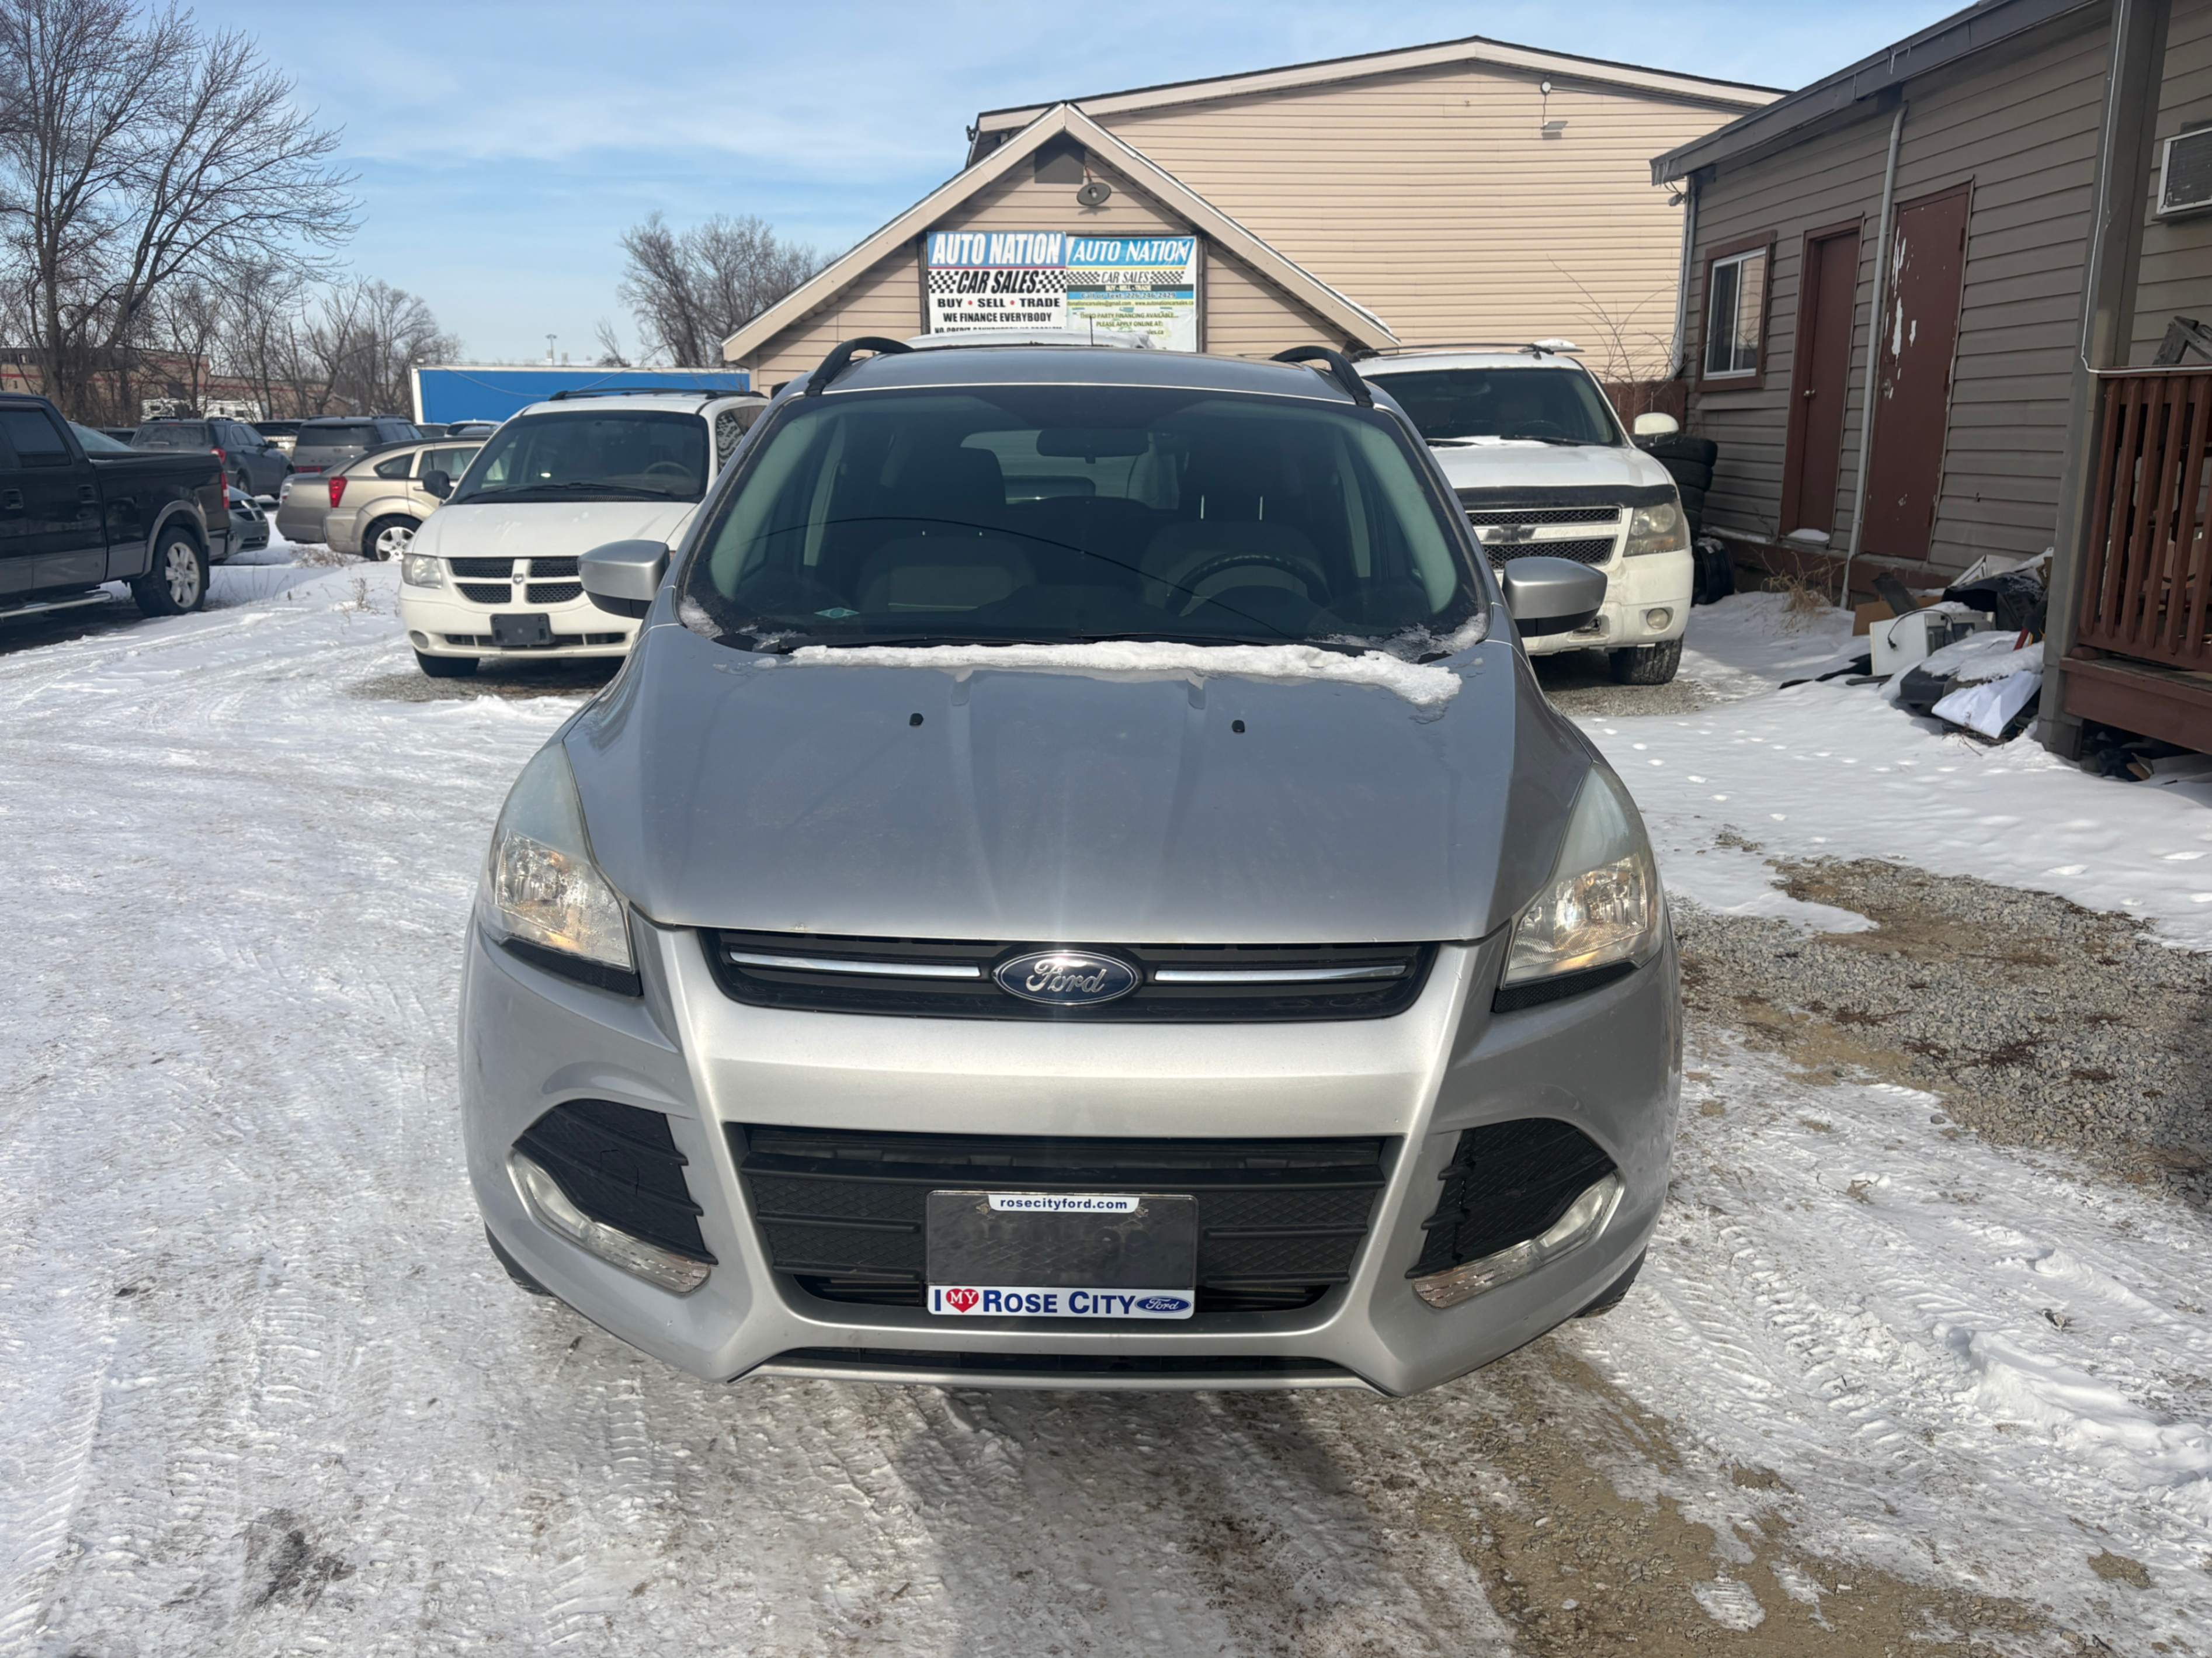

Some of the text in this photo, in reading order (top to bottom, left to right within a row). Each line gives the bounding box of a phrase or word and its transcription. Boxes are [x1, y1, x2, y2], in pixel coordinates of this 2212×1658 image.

[932, 233, 1062, 265] AUTO NATION
[1072, 240, 1190, 262] AUTO NATION
[956, 270, 1039, 294] CAR SALES
[1101, 271, 1150, 284] CAR SALES
[937, 298, 1061, 308] BUY SELL TRADE
[943, 312, 1052, 322] WE FINANCE EVERYBODY
[1026, 958, 1107, 993] Ford
[999, 1198, 1128, 1210] rosecityford.com
[934, 1289, 1179, 1314] I MY ROSE CITY Ford
